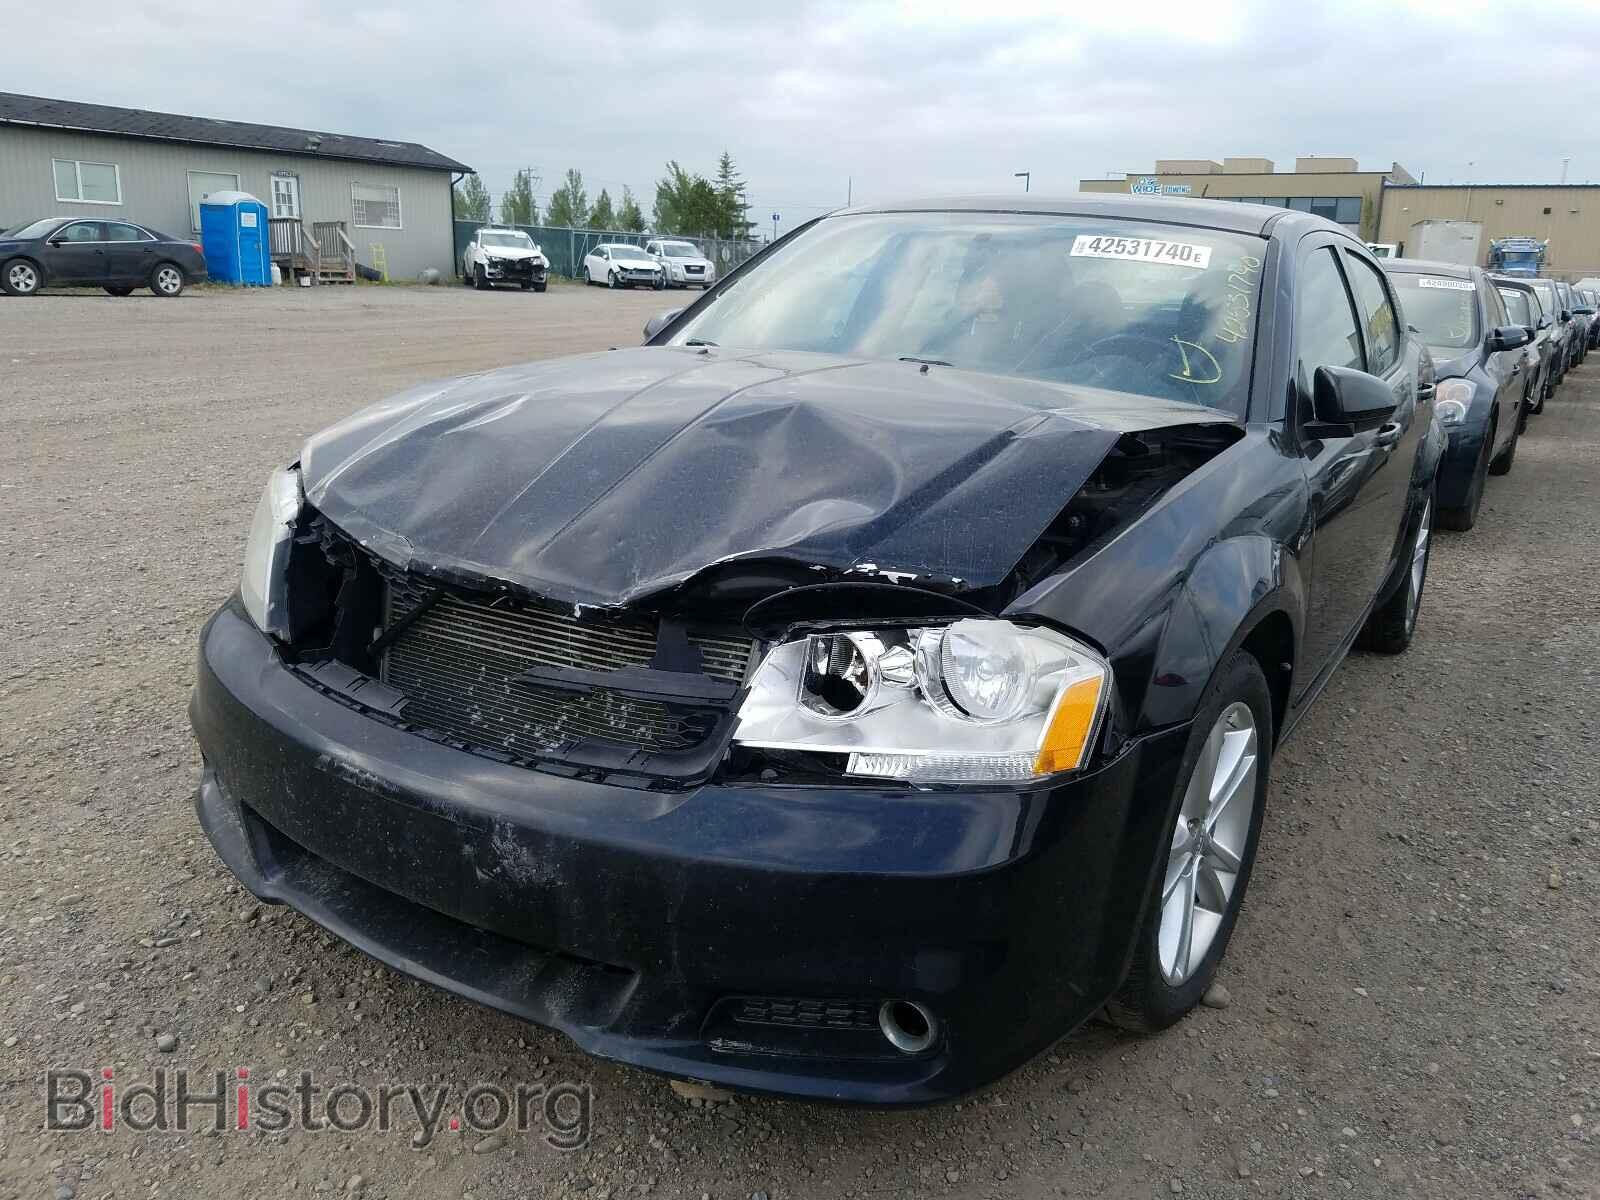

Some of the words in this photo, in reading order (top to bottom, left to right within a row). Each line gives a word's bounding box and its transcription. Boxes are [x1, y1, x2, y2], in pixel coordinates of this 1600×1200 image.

[1130, 184, 1160, 194] WIDE
[1088, 236, 1193, 262] 42531740
[1167, 334, 1221, 384] D
